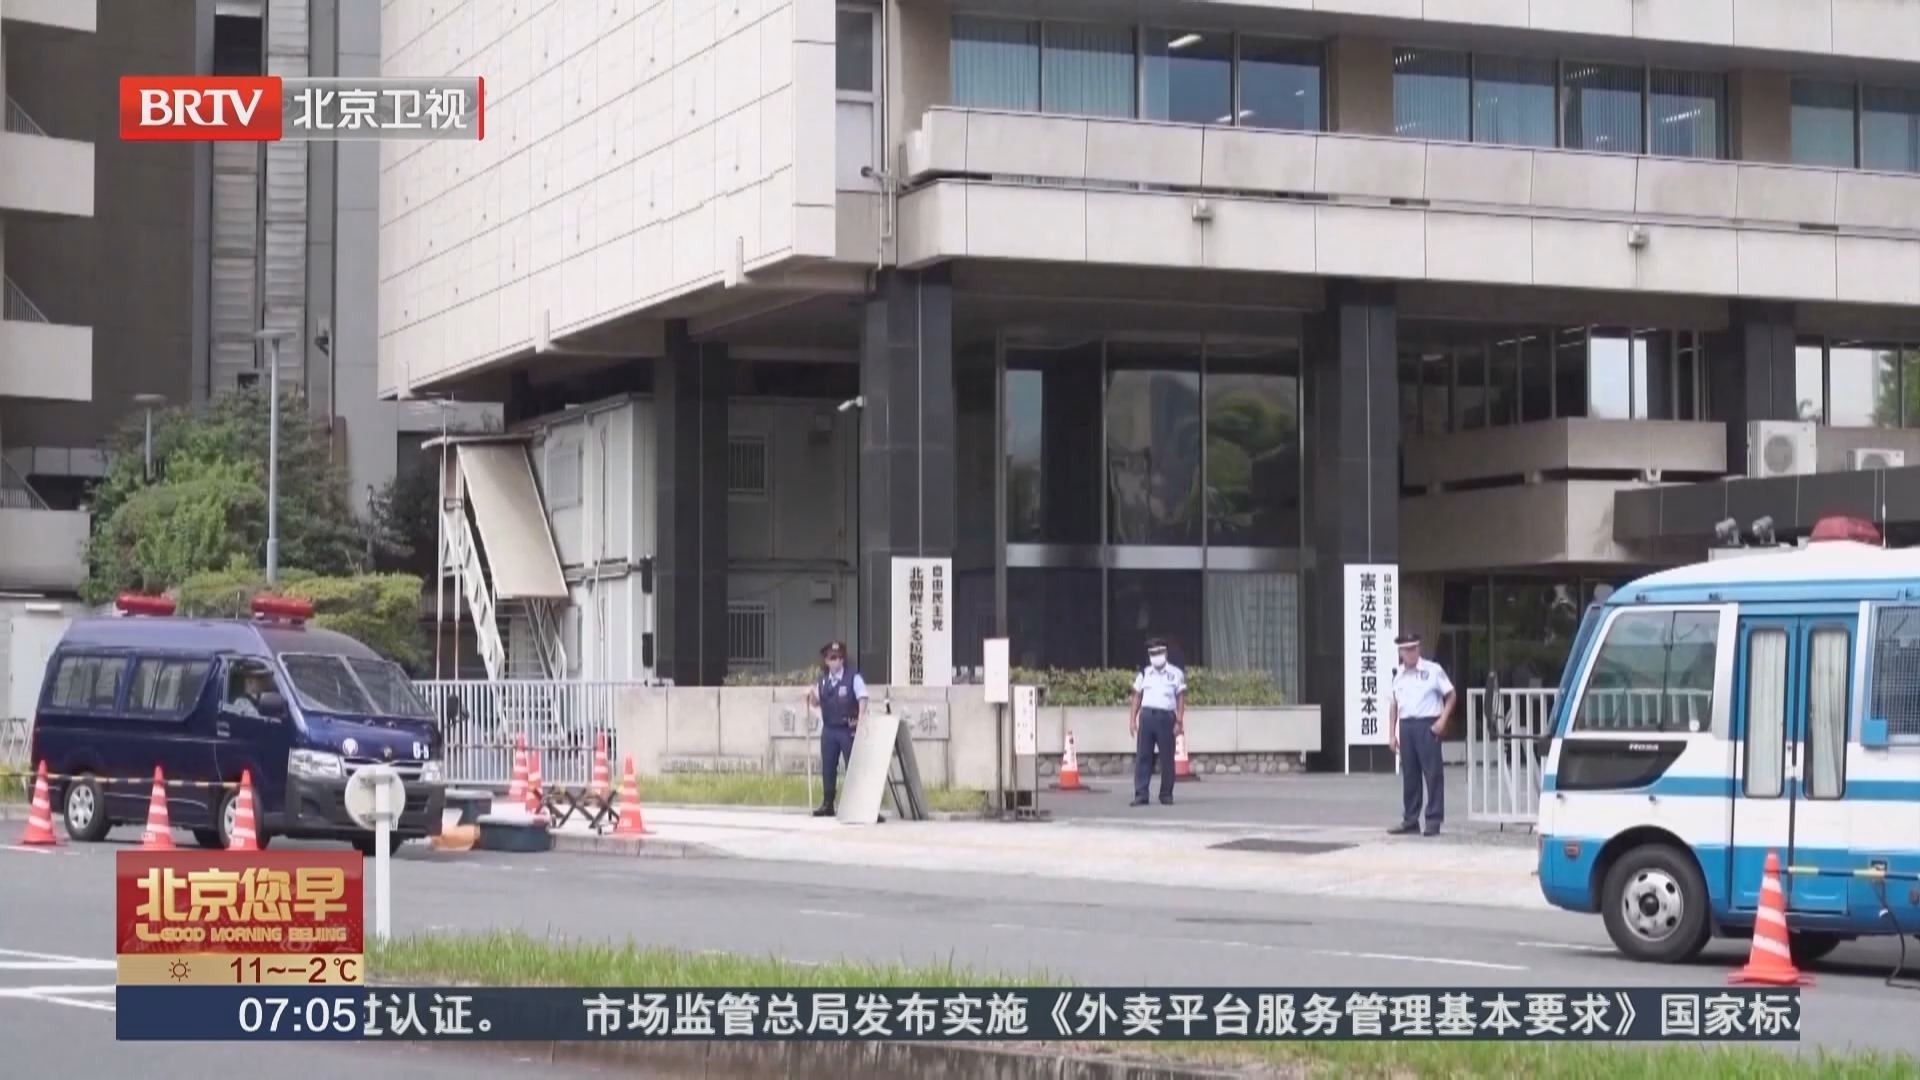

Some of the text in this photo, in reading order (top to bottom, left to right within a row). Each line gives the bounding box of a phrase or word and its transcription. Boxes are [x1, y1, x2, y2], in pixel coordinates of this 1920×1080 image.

[932, 565, 943, 632] 自由民主党
[1360, 573, 1378, 736] 憲法改正実現本部
